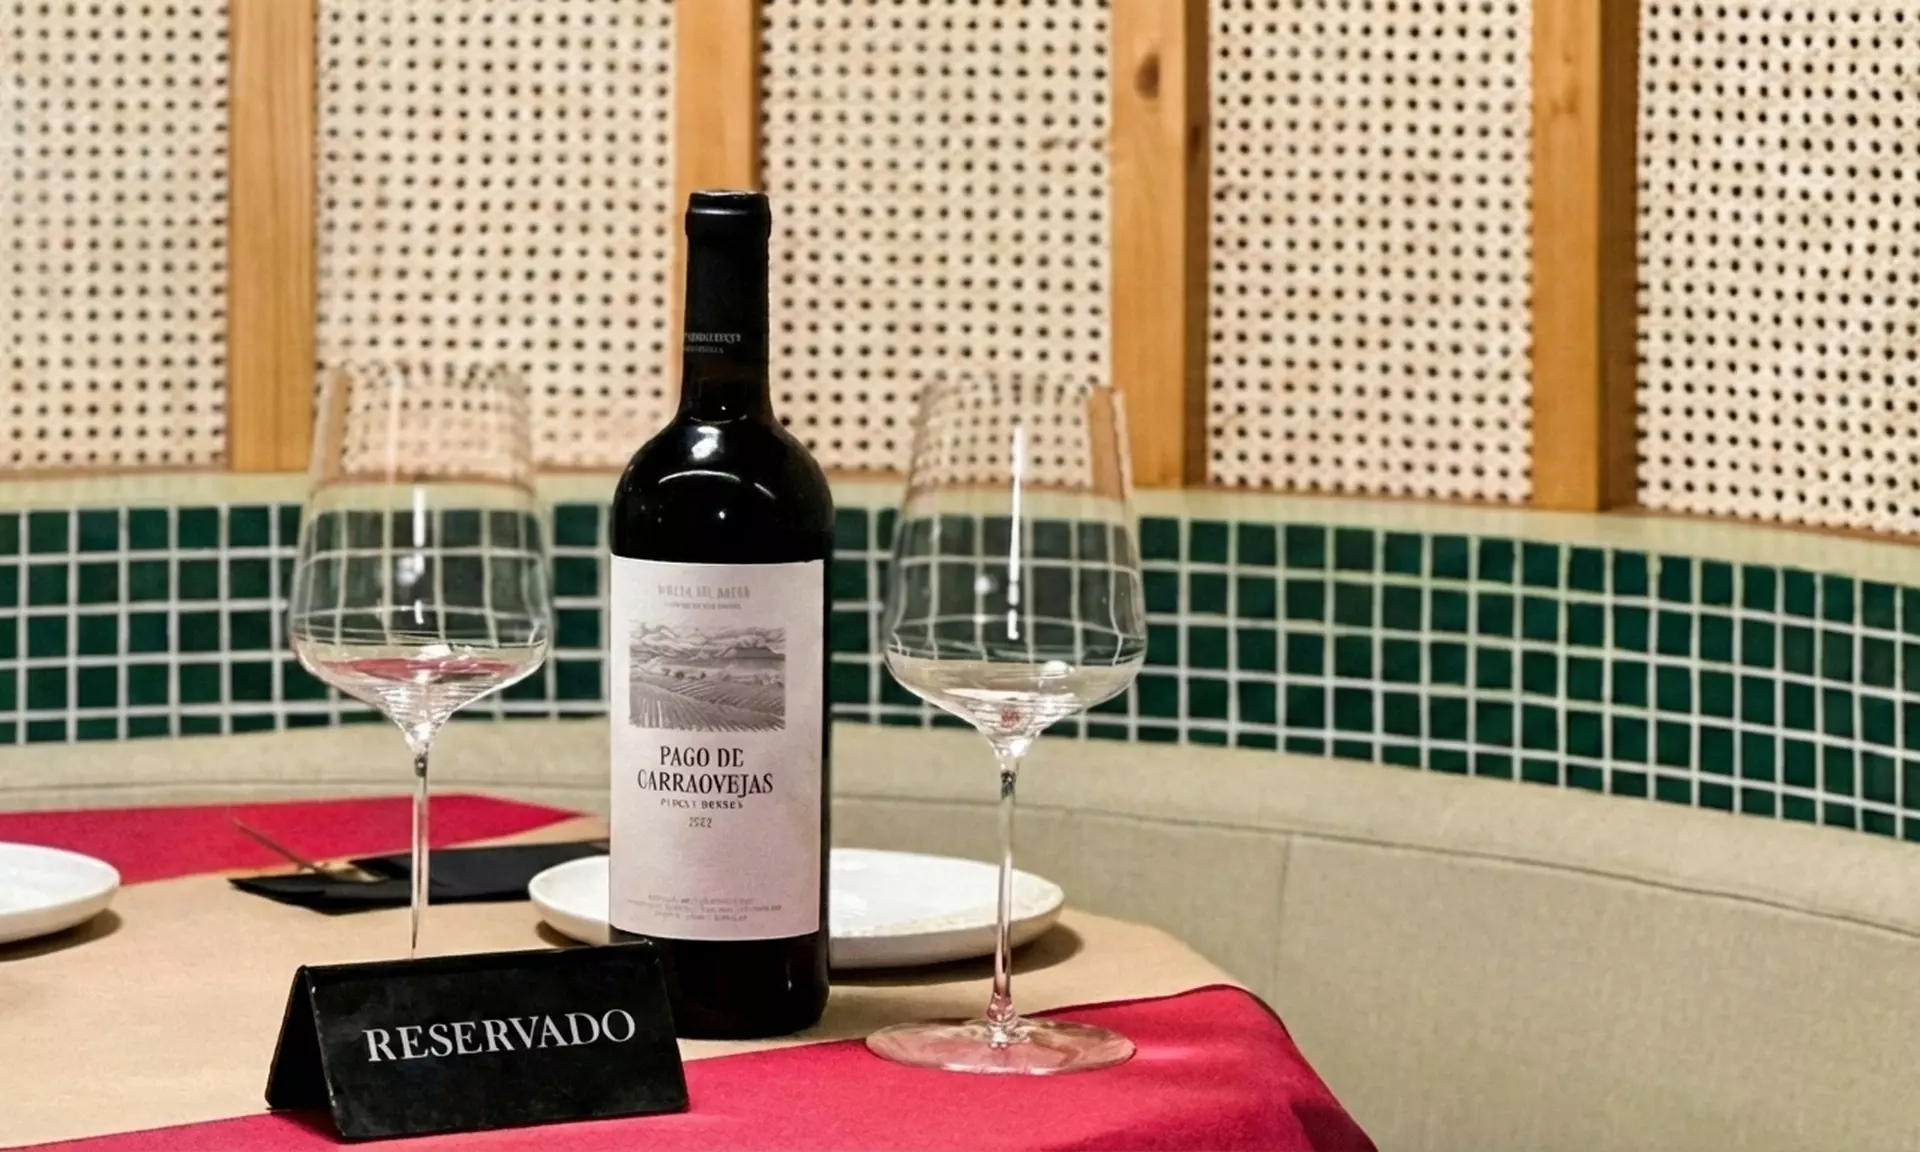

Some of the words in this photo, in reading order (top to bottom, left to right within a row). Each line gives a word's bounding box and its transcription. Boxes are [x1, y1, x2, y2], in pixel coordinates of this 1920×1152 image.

[660, 745, 710, 767] PAGO
[717, 748, 744, 768] DE
[637, 768, 773, 798] CARRAOVEJAS
[362, 1009, 635, 1062] RESERVADO
